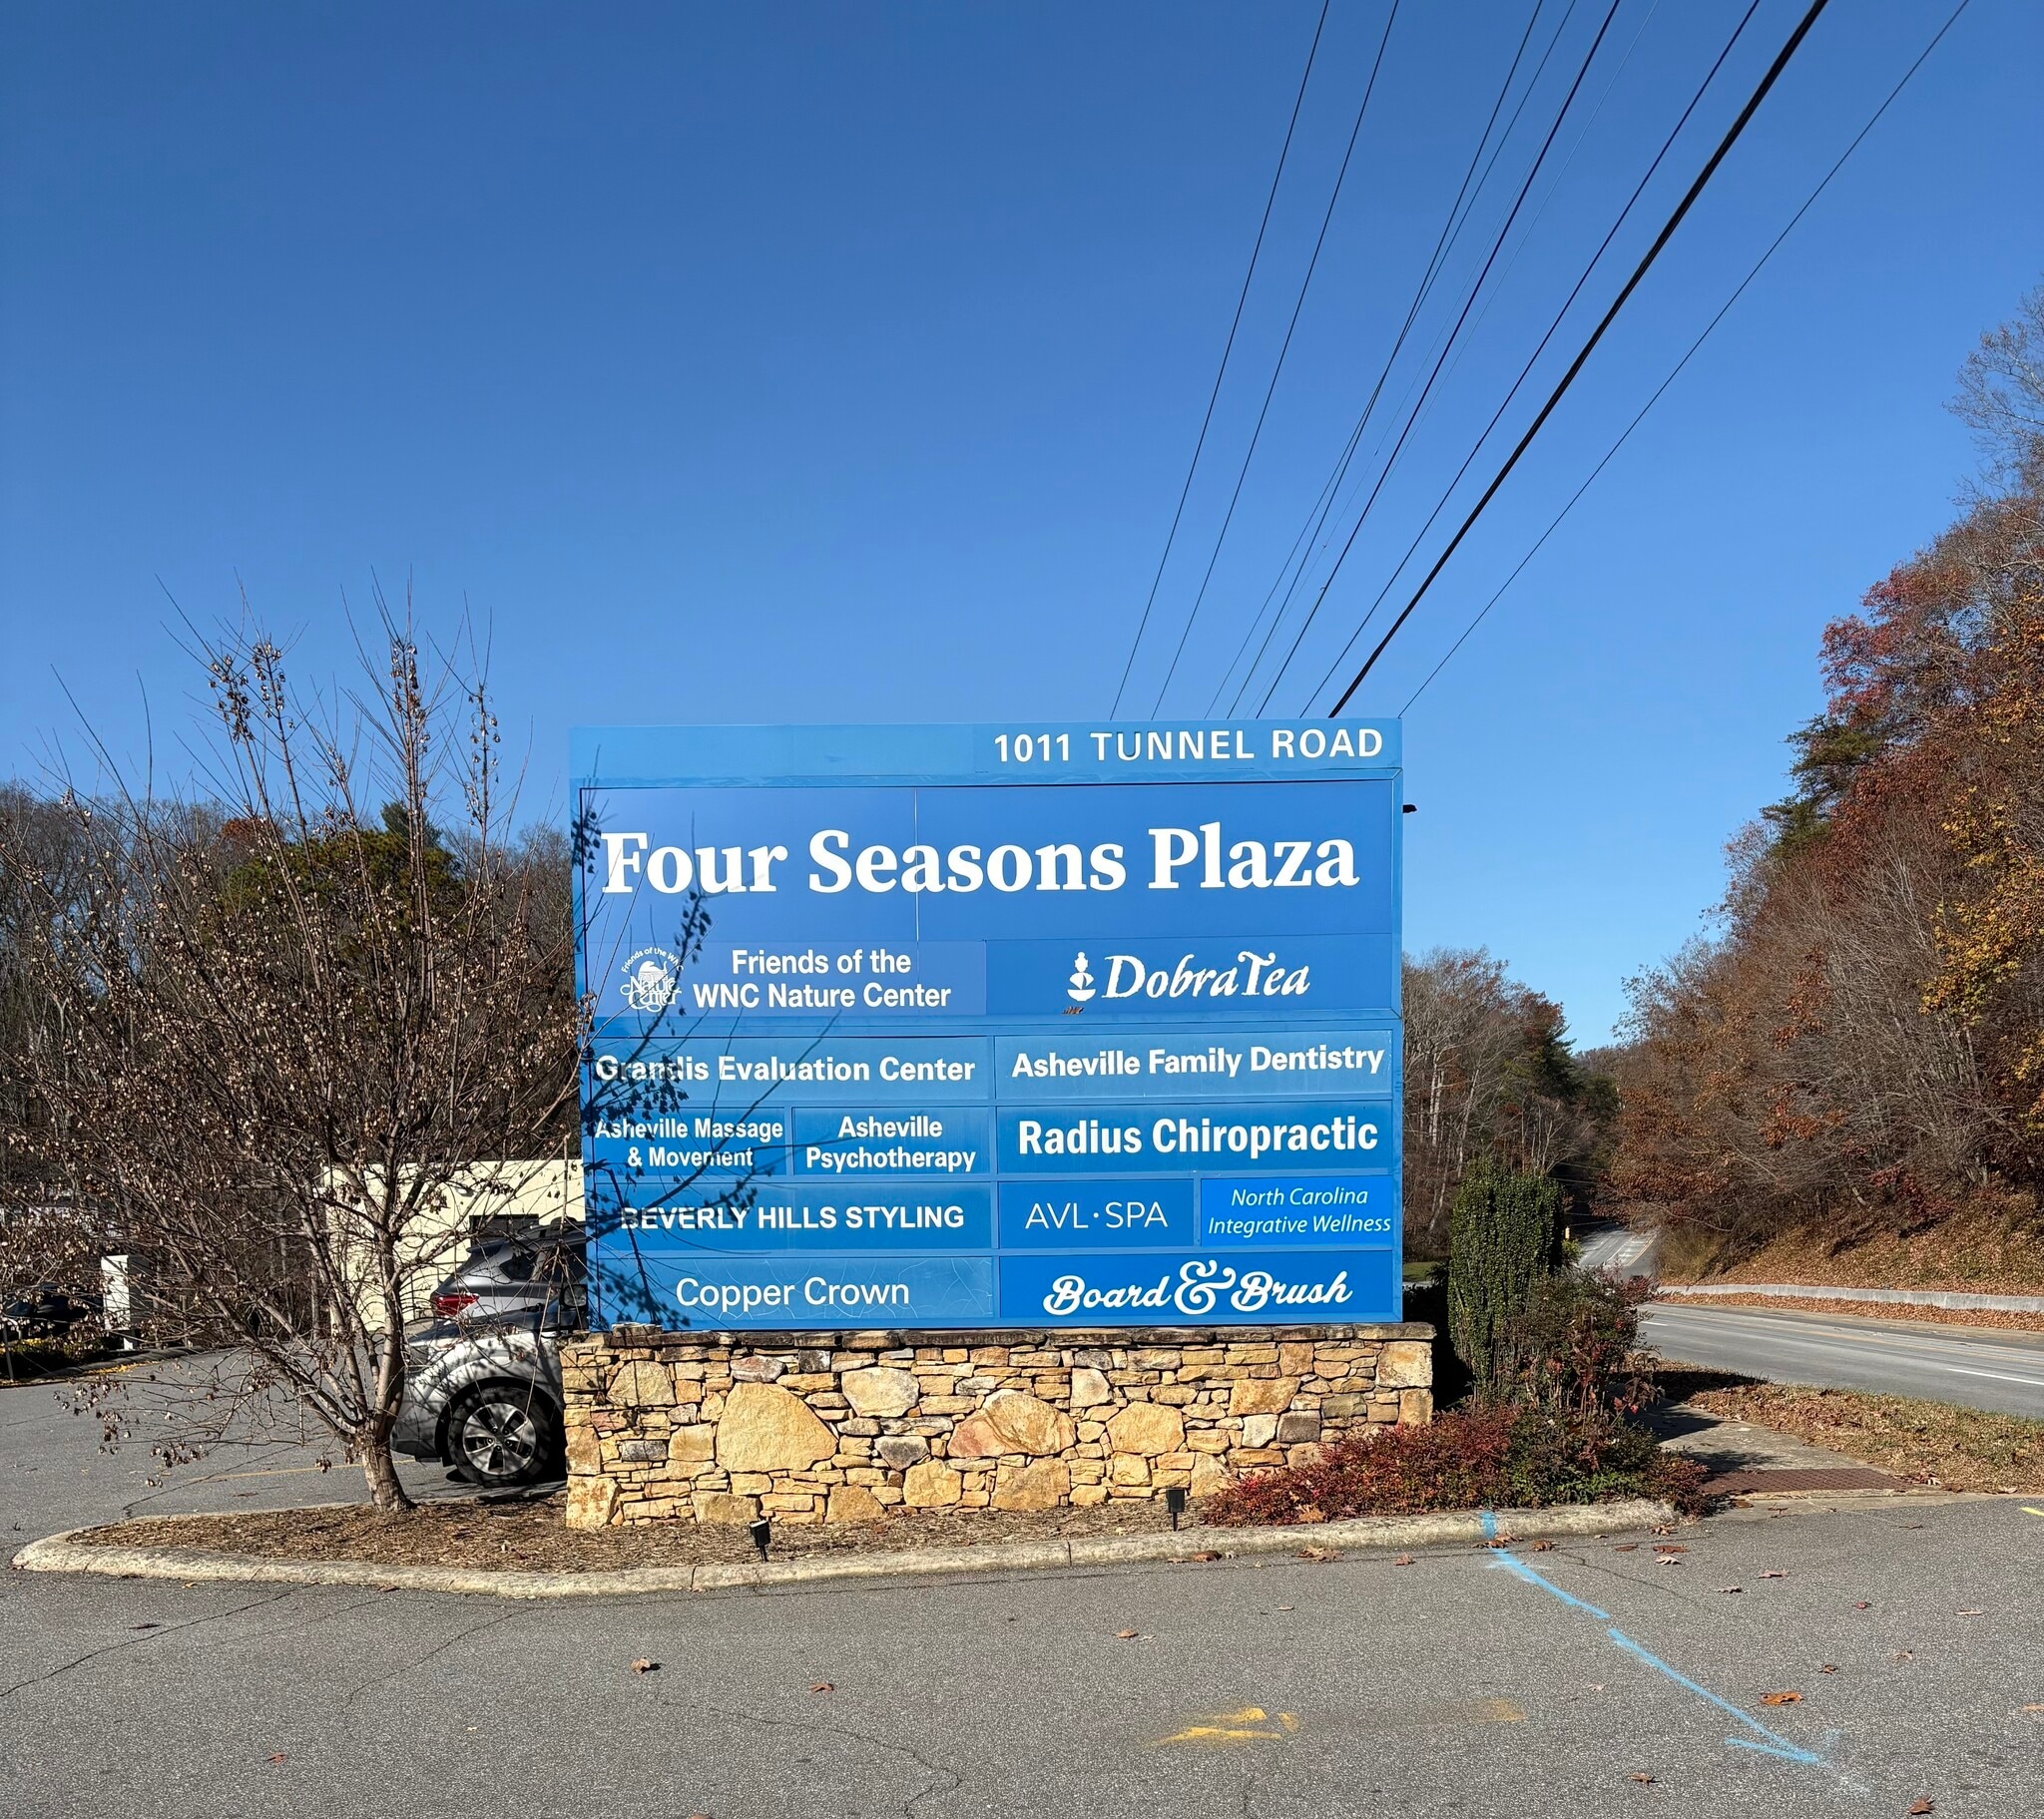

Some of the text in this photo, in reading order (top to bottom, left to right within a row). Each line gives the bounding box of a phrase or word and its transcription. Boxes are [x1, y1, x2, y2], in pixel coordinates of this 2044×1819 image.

[994, 728, 1383, 762] 1011 TUNNEL ROAD
[601, 821, 1360, 894] Four Seasons Plaza
[732, 949, 912, 974] Friends of the
[693, 983, 951, 1009] WNC Nature Center
[595, 1055, 976, 1082] Grandis Evaluation Center
[1011, 1045, 1385, 1078] Asheville Family Dentistry
[595, 1118, 783, 1142] Asheville Massage
[837, 1116, 942, 1137] Asheville
[1018, 1116, 1378, 1159] Radius Chiropractic
[628, 1147, 754, 1167] & Movement
[806, 1146, 976, 1172] Psychotherapy
[1231, 1186, 1368, 1205] North Carolina
[620, 1205, 964, 1230] BEVERLY HILLS STYLING
[1208, 1214, 1391, 1237] Integrative Wellness
[676, 1276, 910, 1312] Copper Crown
[1043, 1259, 1353, 1315] Board & Brush
